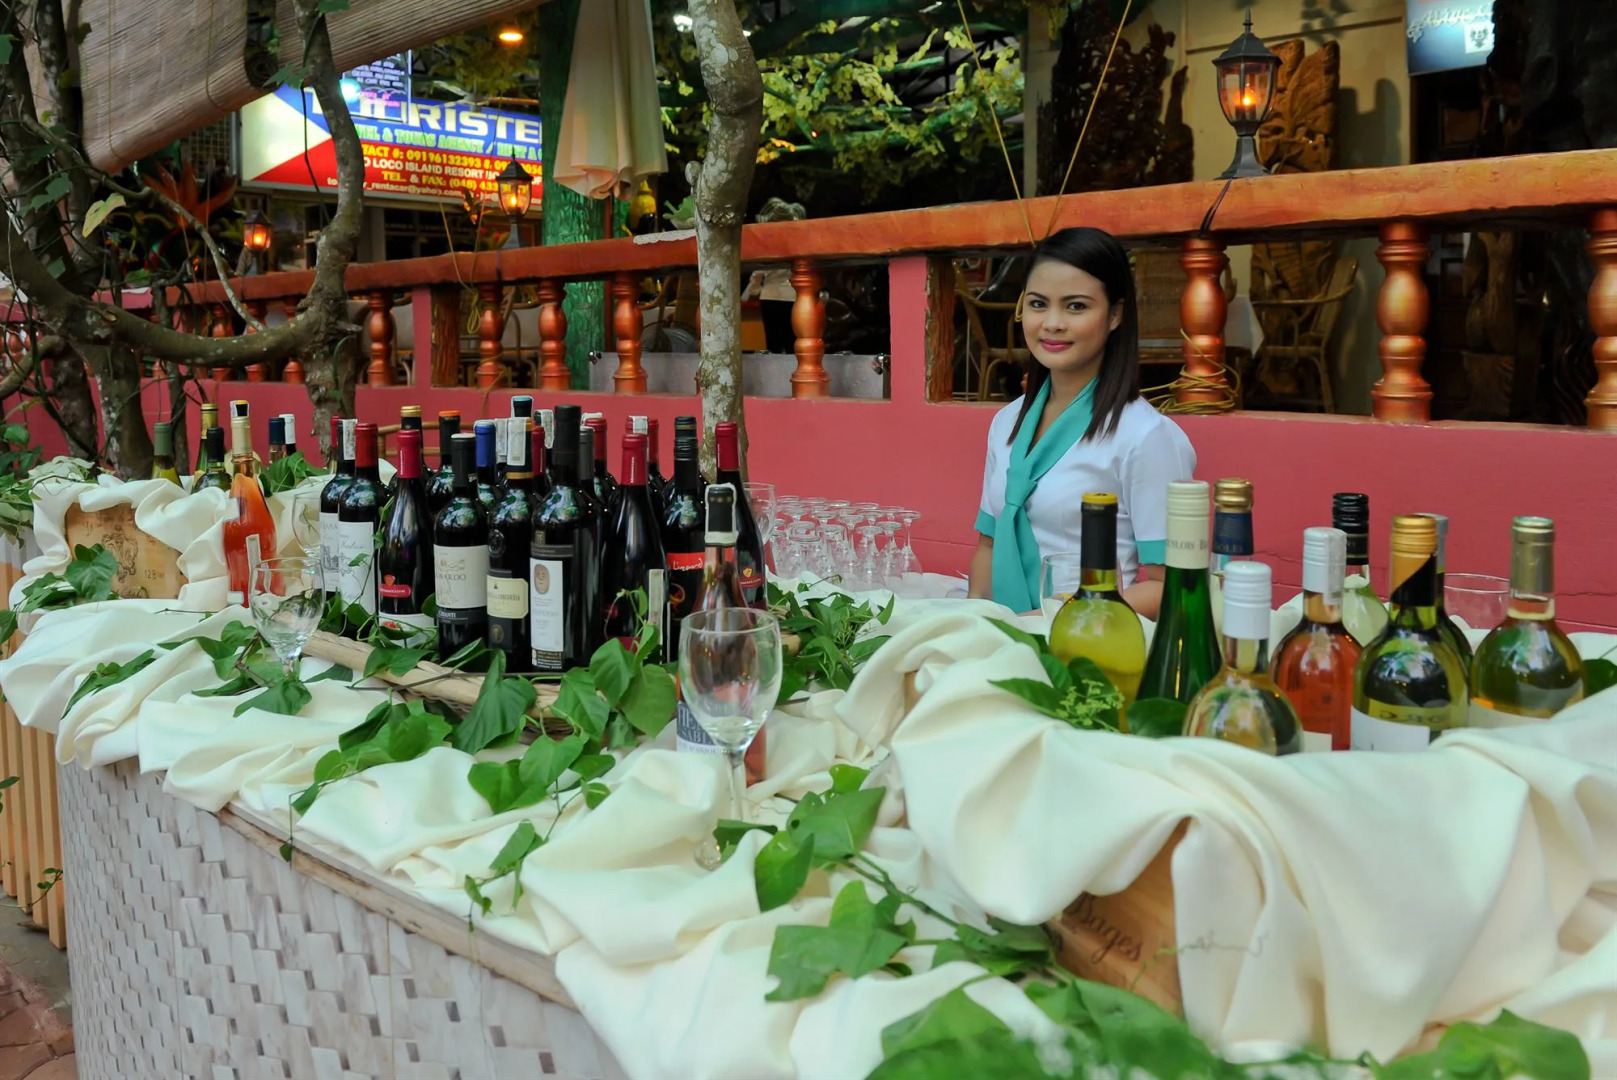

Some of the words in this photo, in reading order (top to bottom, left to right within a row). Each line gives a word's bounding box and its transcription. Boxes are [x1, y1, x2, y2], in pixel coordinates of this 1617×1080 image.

[361, 144, 390, 157] TACT
[373, 157, 404, 170] LOCO
[405, 162, 443, 175] ISLAND
[444, 166, 485, 179] RESORT
[382, 170, 407, 182] TEL.
[409, 173, 420, 183] &
